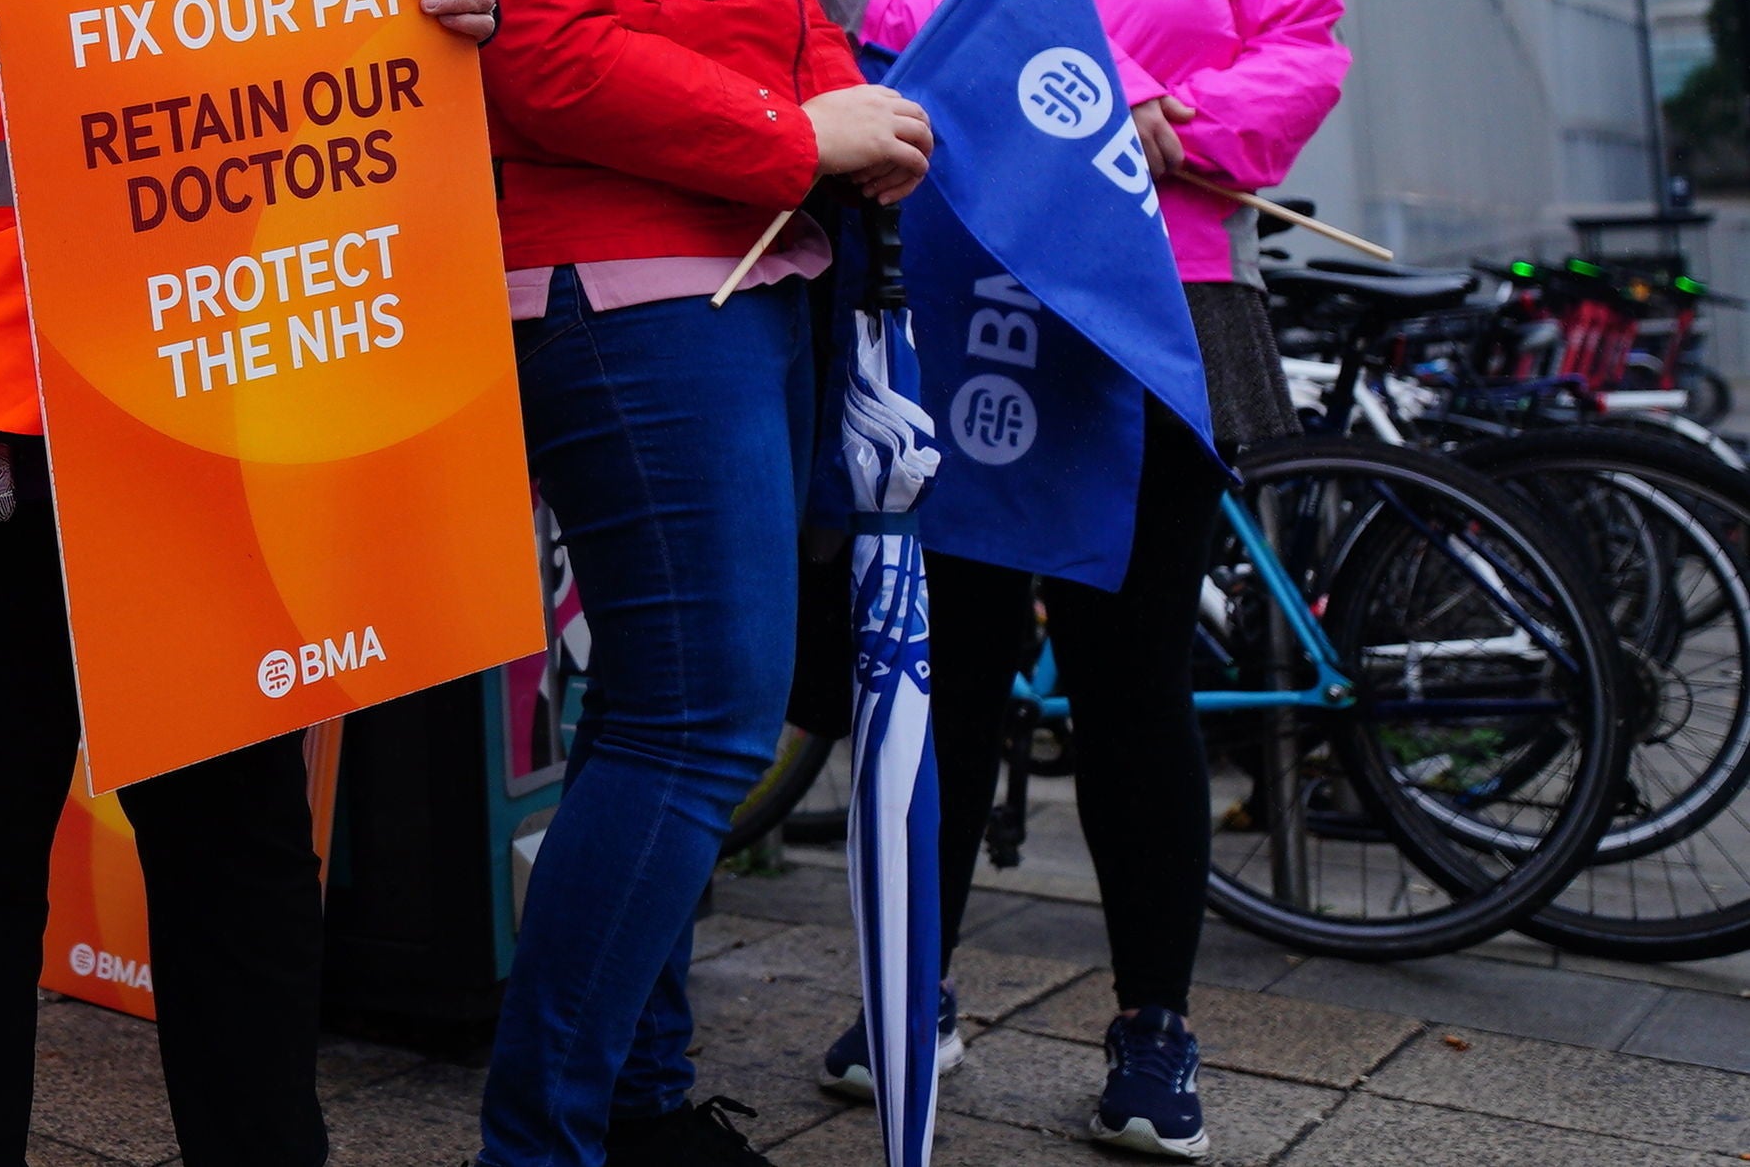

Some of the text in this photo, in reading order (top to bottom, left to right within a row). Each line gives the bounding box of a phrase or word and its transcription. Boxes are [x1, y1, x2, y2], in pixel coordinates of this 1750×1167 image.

[68, 0, 163, 69] FIX
[80, 57, 424, 171] RETAIN OUR
[126, 129, 399, 234] DOCTORS
[147, 224, 400, 332] PROTECT
[158, 293, 404, 398] THE NHS
[298, 625, 386, 685] BMA
[96, 951, 153, 992] BMA
